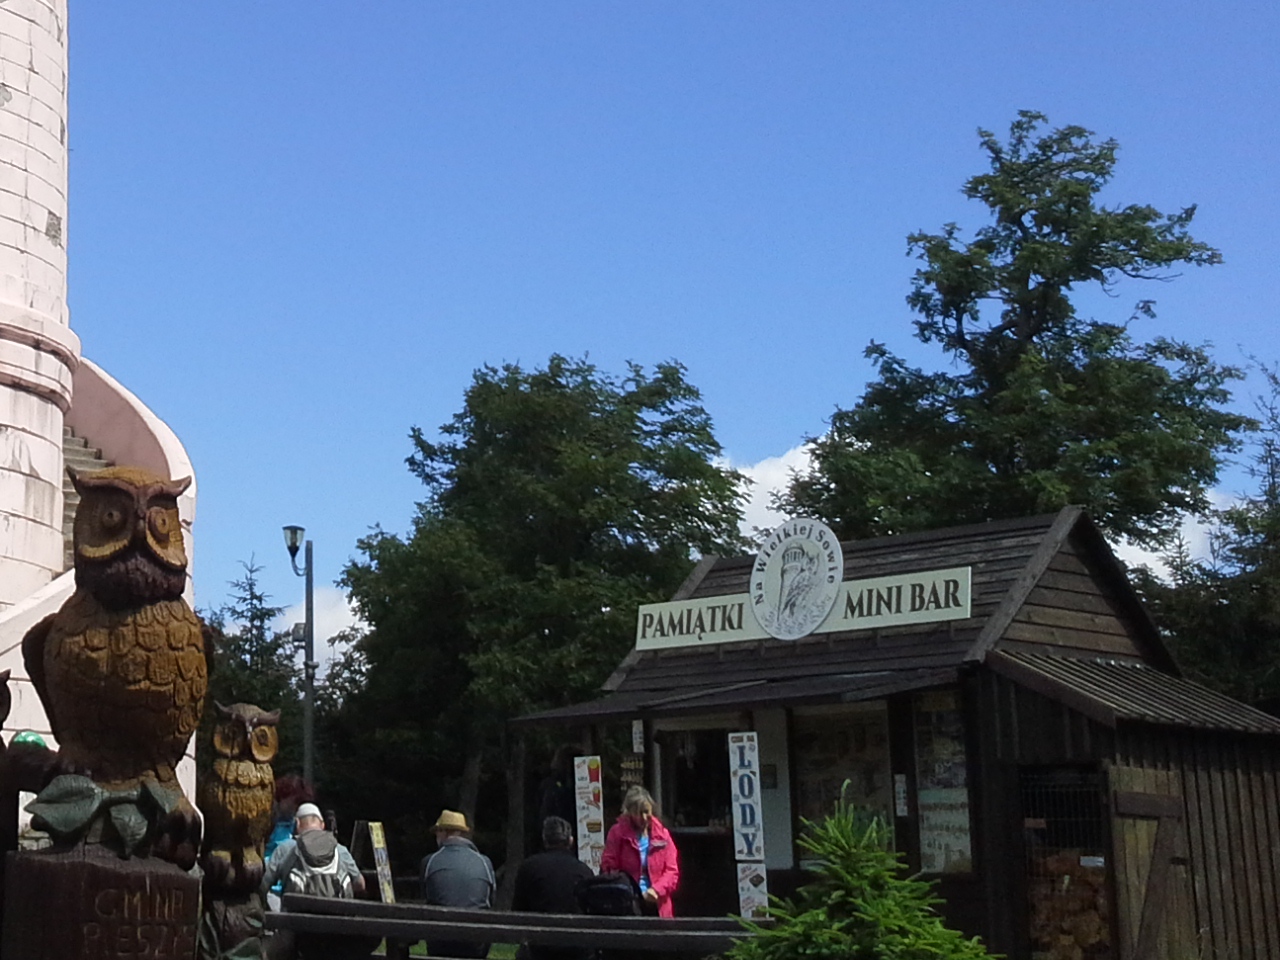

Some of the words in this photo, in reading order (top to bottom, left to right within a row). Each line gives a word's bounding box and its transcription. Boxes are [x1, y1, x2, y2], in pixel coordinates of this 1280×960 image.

[641, 603, 744, 640] PAMIĄTKI
[842, 585, 903, 619] MINI
[909, 579, 963, 612] BAR
[736, 744, 757, 858] LODY
